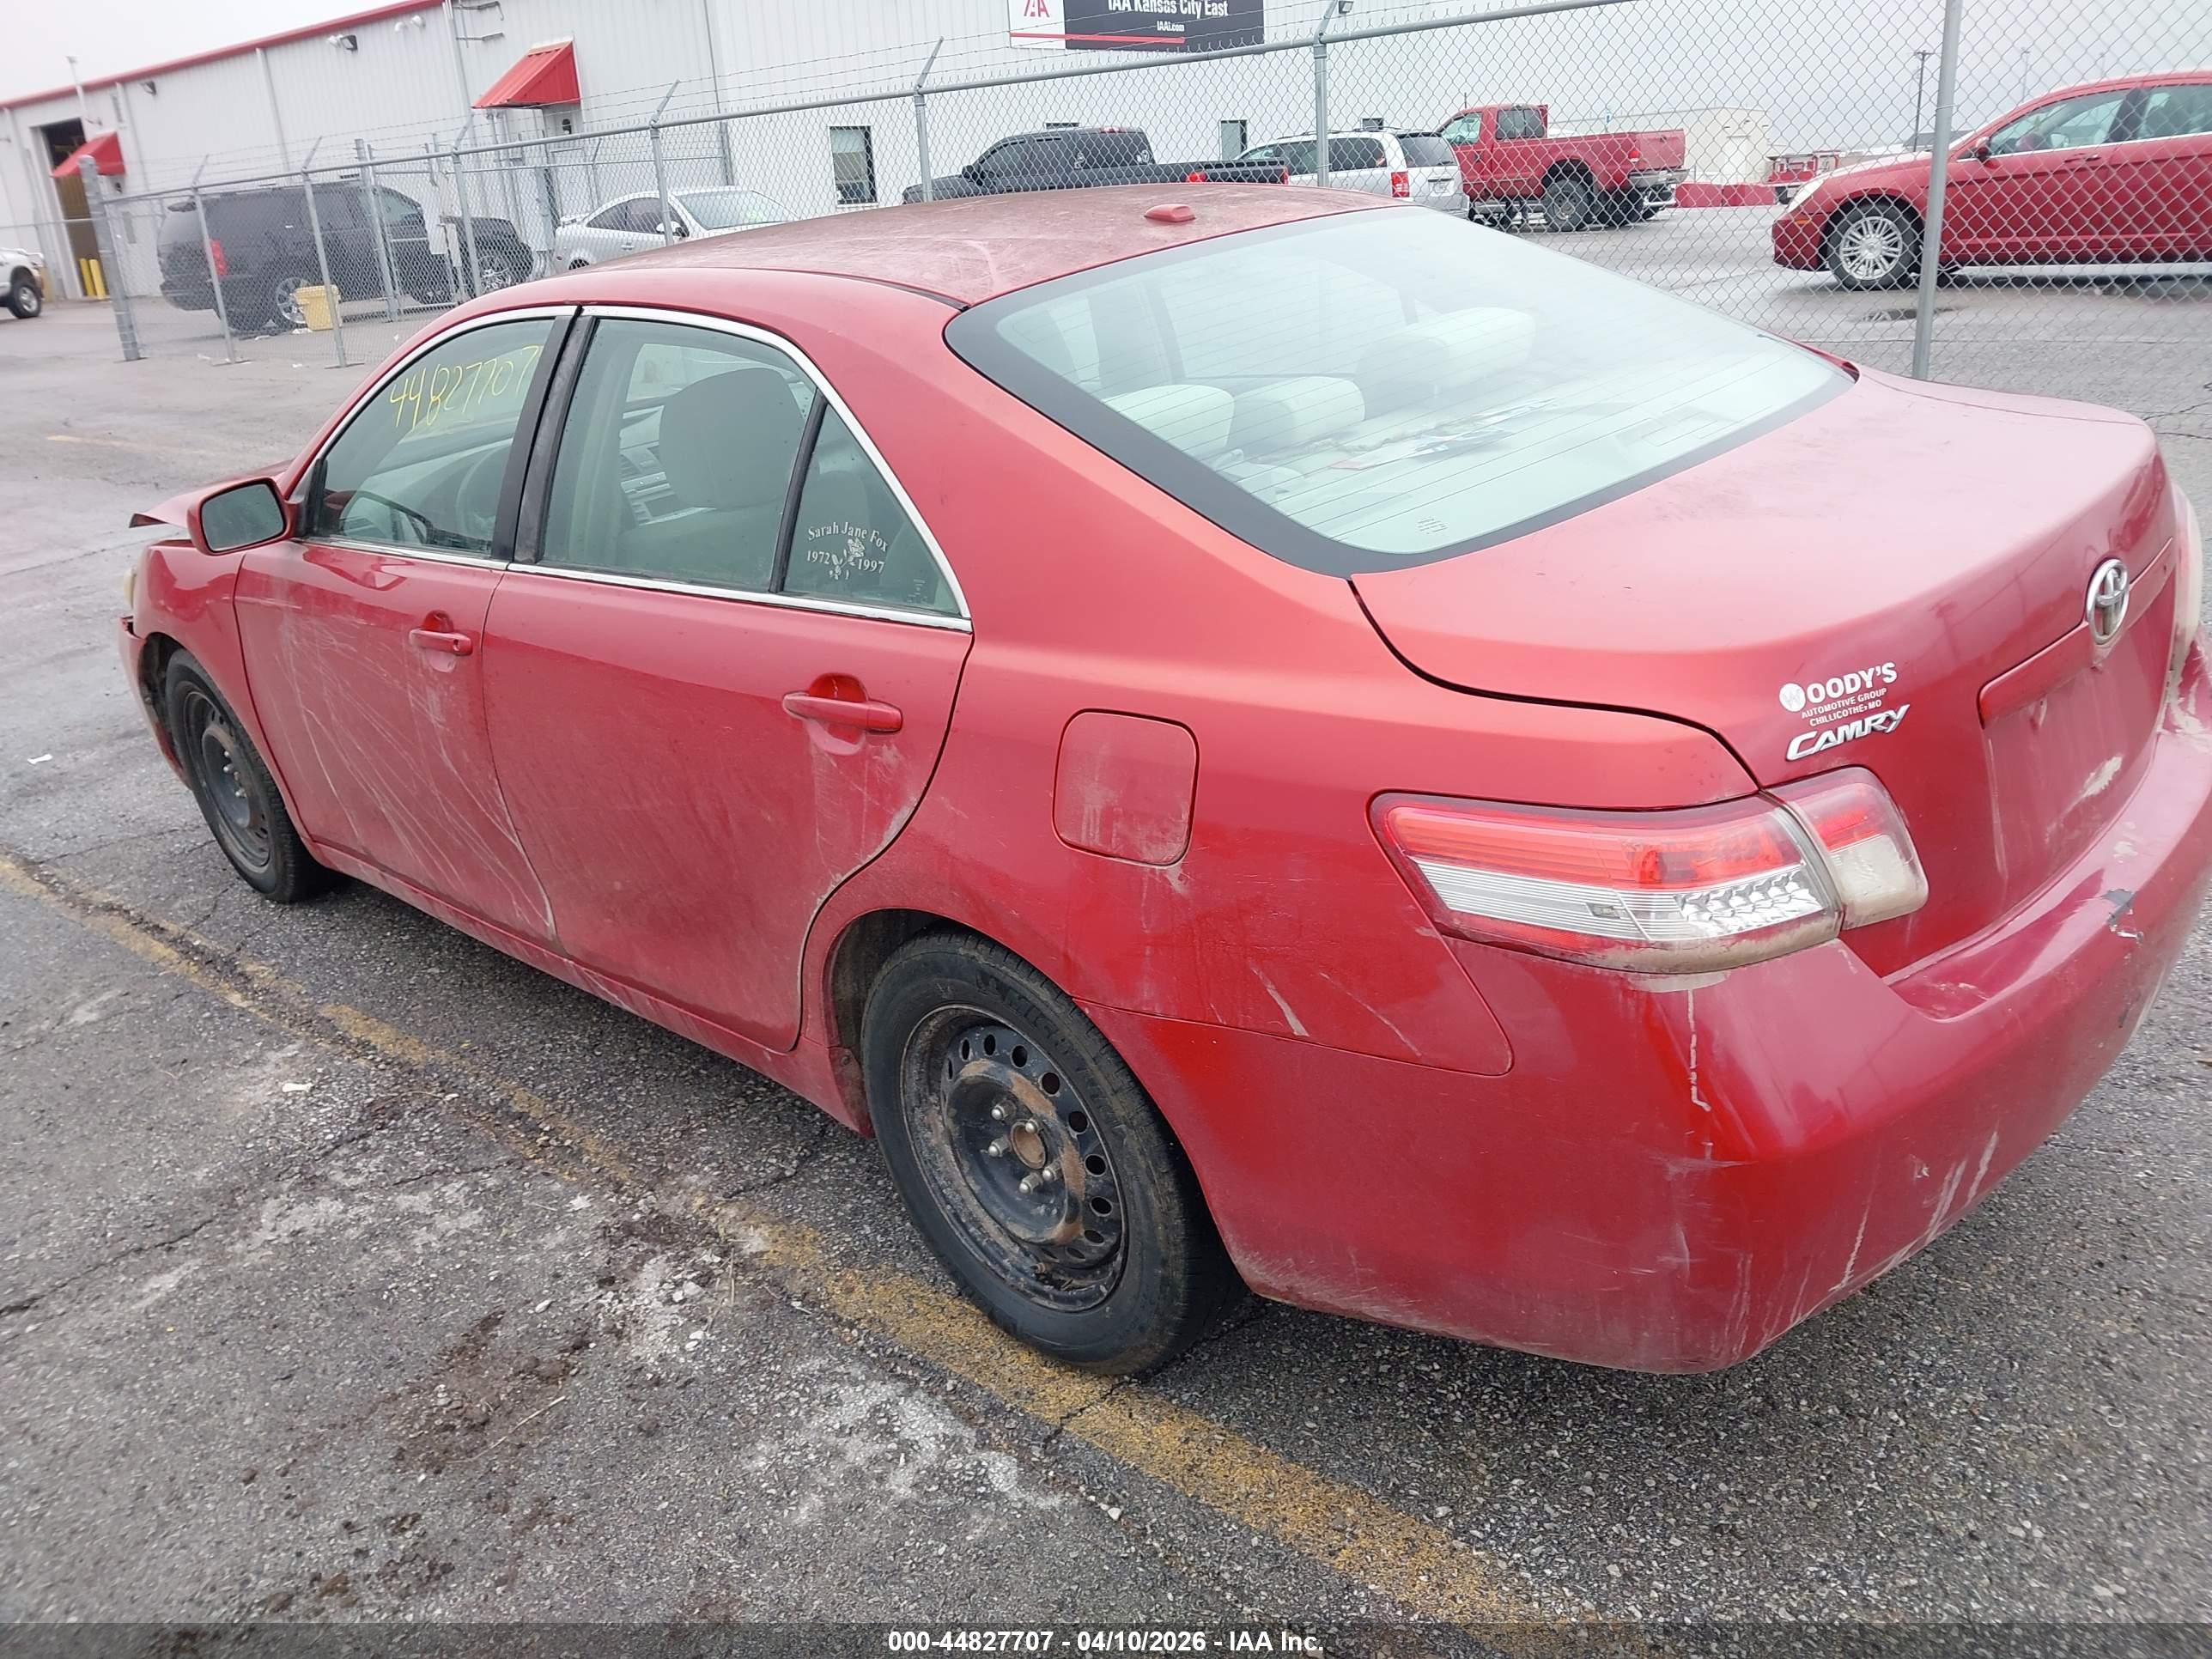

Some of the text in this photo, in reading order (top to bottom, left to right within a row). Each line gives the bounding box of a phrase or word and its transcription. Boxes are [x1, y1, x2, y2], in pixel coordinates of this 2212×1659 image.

[1109, 0, 1229, 19] IAA Kansas City East
[1157, 21, 1185, 32] IAAi.com
[390, 345, 541, 430] 44827707
[808, 522, 889, 552] Sarah Jane Fox
[806, 550, 885, 574] 1972 1997
[1802, 688, 1887, 720] AUTOMOTIVE GROUP
[1869, 699, 1882, 709] MO
[1786, 703, 1911, 762] CAMRY
